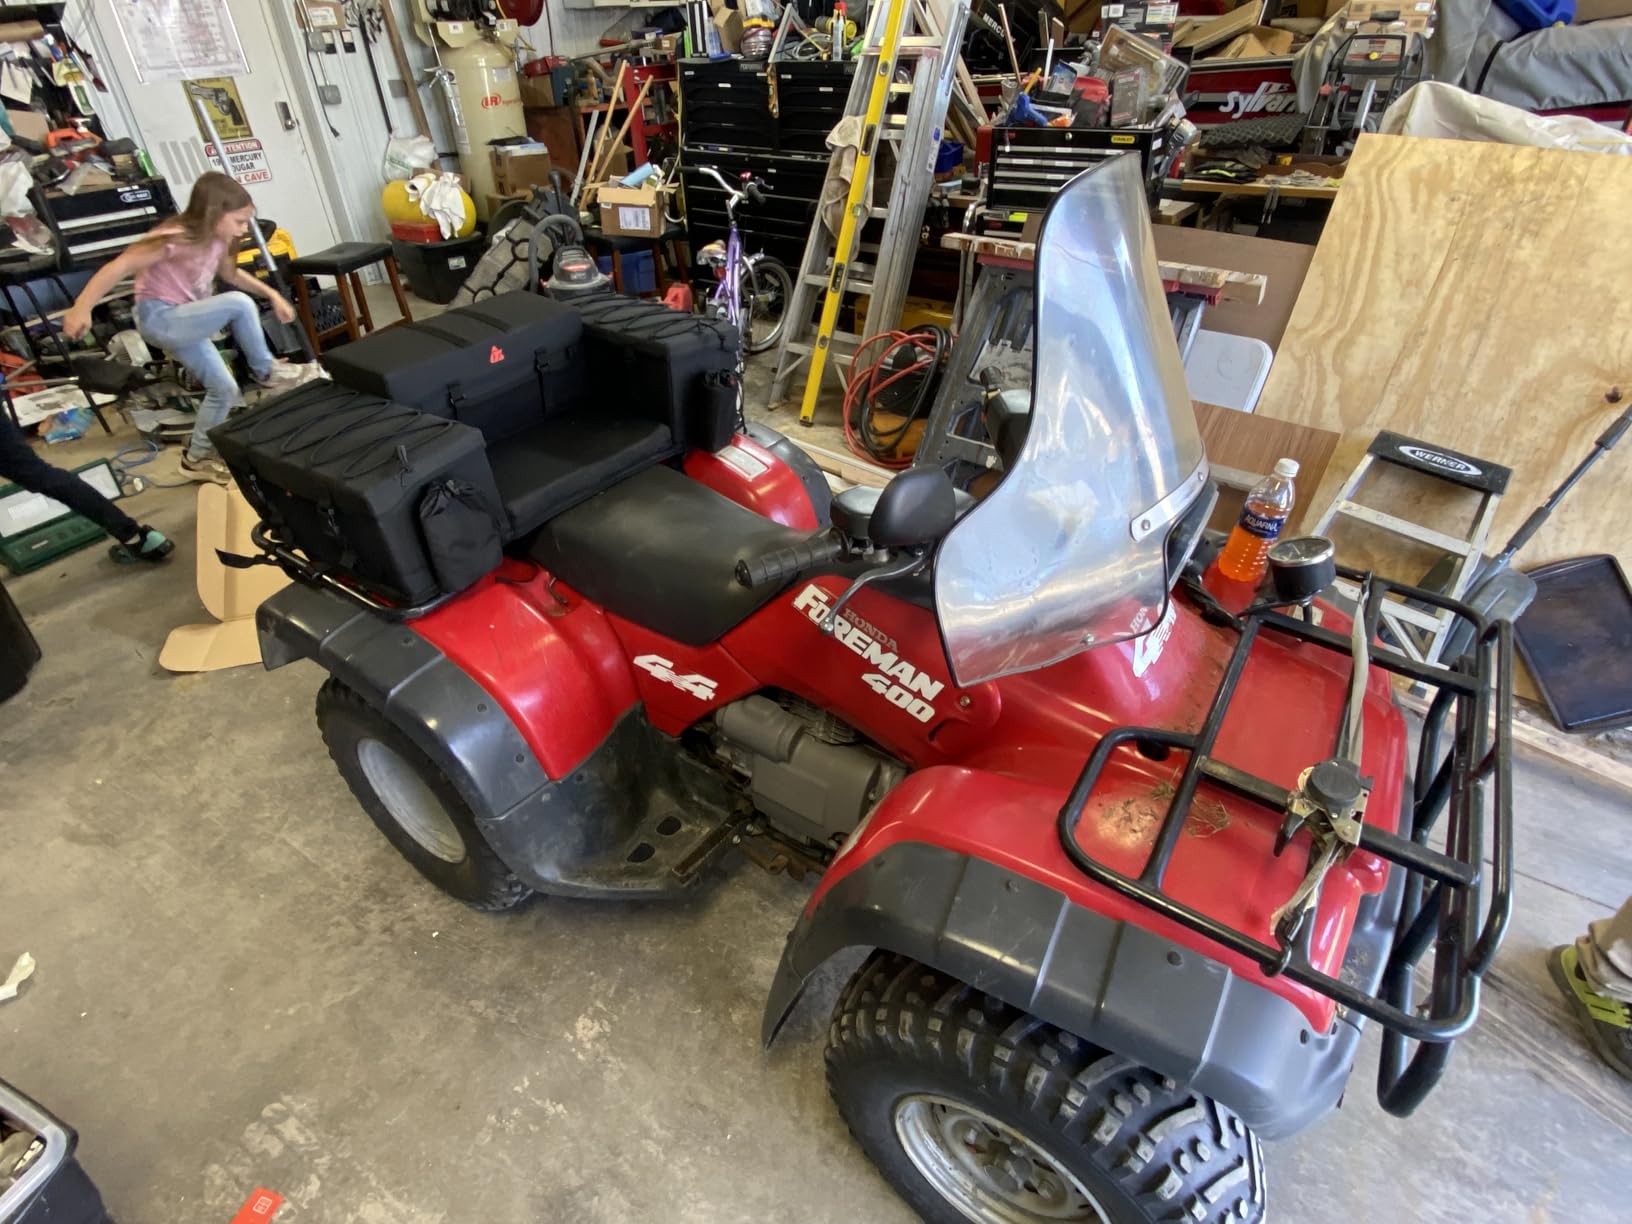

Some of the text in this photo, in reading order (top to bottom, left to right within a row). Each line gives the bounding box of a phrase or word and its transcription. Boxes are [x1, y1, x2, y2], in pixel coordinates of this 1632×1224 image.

[229, 152, 262, 161] MERCURY
[231, 162, 255, 172] OUGAR
[244, 171, 269, 181] CAVE
[1415, 450, 1467, 470] WERNER
[843, 608, 898, 653] HONDA
[793, 584, 945, 701] FOREMAN
[861, 673, 936, 723] 400
